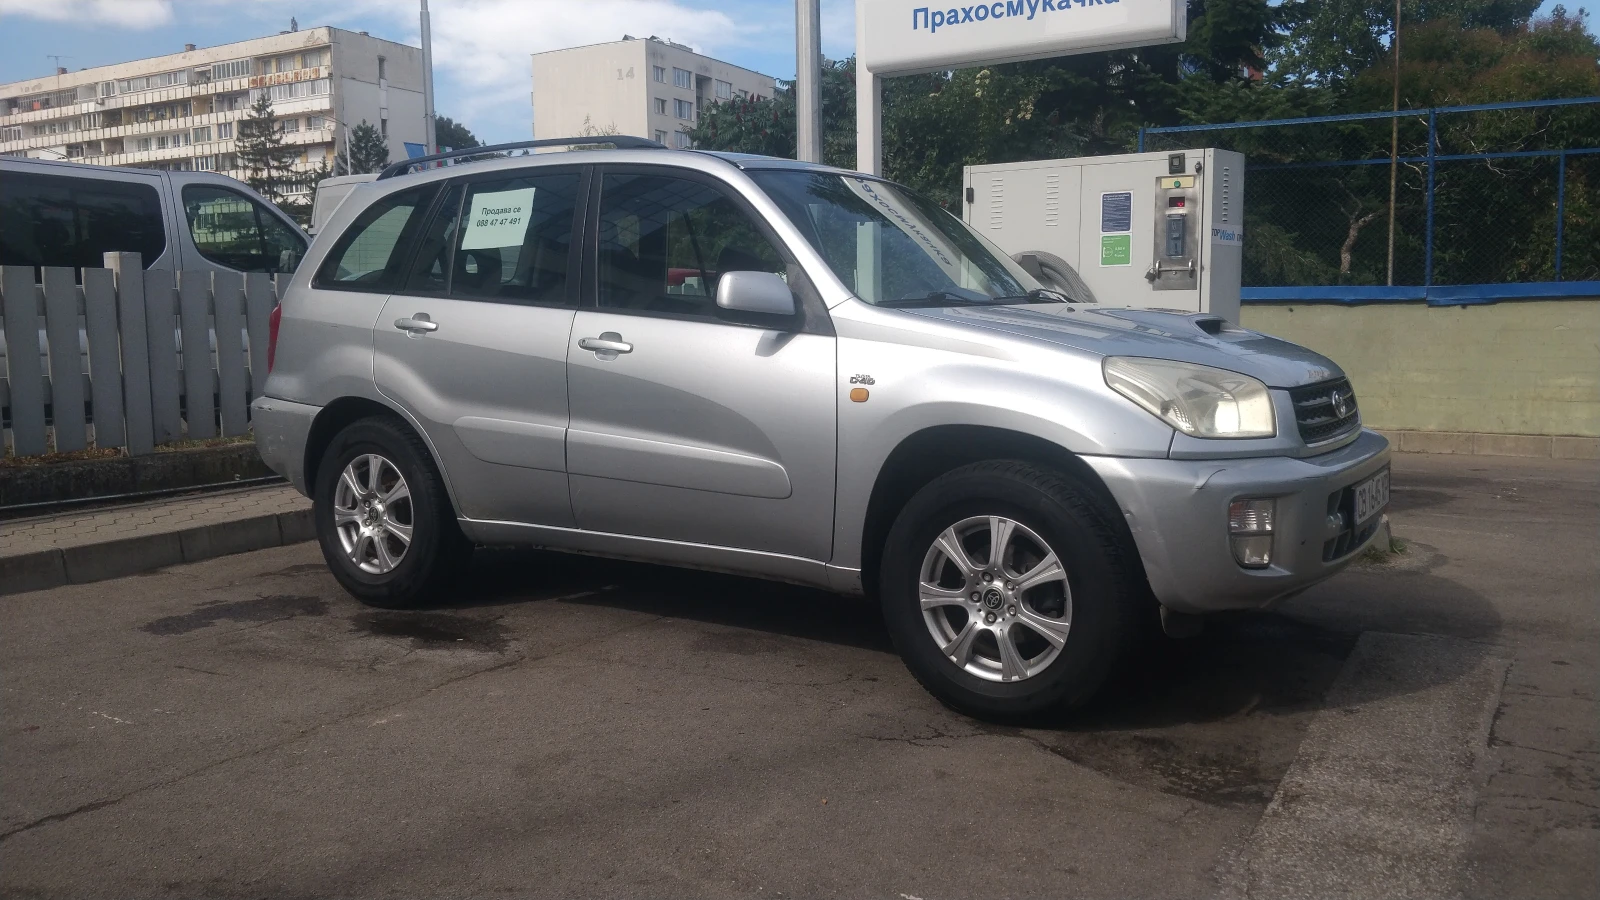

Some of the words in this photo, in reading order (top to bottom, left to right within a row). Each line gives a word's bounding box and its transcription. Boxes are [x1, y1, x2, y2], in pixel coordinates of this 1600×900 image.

[616, 66, 635, 80] 14
[481, 207, 512, 216] Продава
[476, 219, 489, 227] 088
[499, 218, 508, 226] 47
[508, 217, 521, 225] 491
